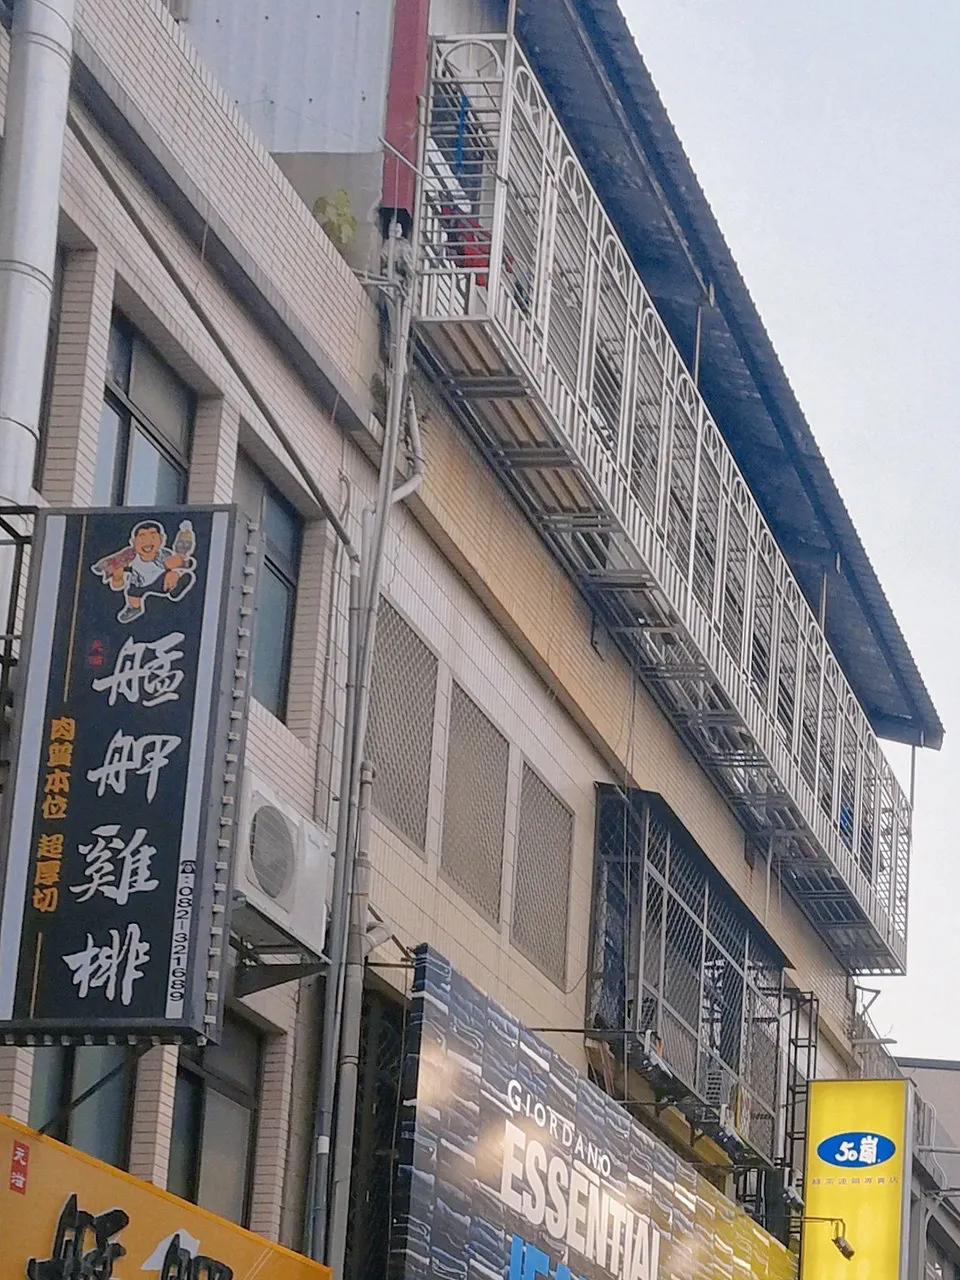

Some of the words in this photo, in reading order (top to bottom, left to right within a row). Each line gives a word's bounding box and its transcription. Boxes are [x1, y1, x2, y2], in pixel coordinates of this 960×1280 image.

[62, 631, 186, 1006] 艋舺雞排
[506, 1077, 613, 1178] GIORDANO
[834, 1135, 879, 1164] 50嵐
